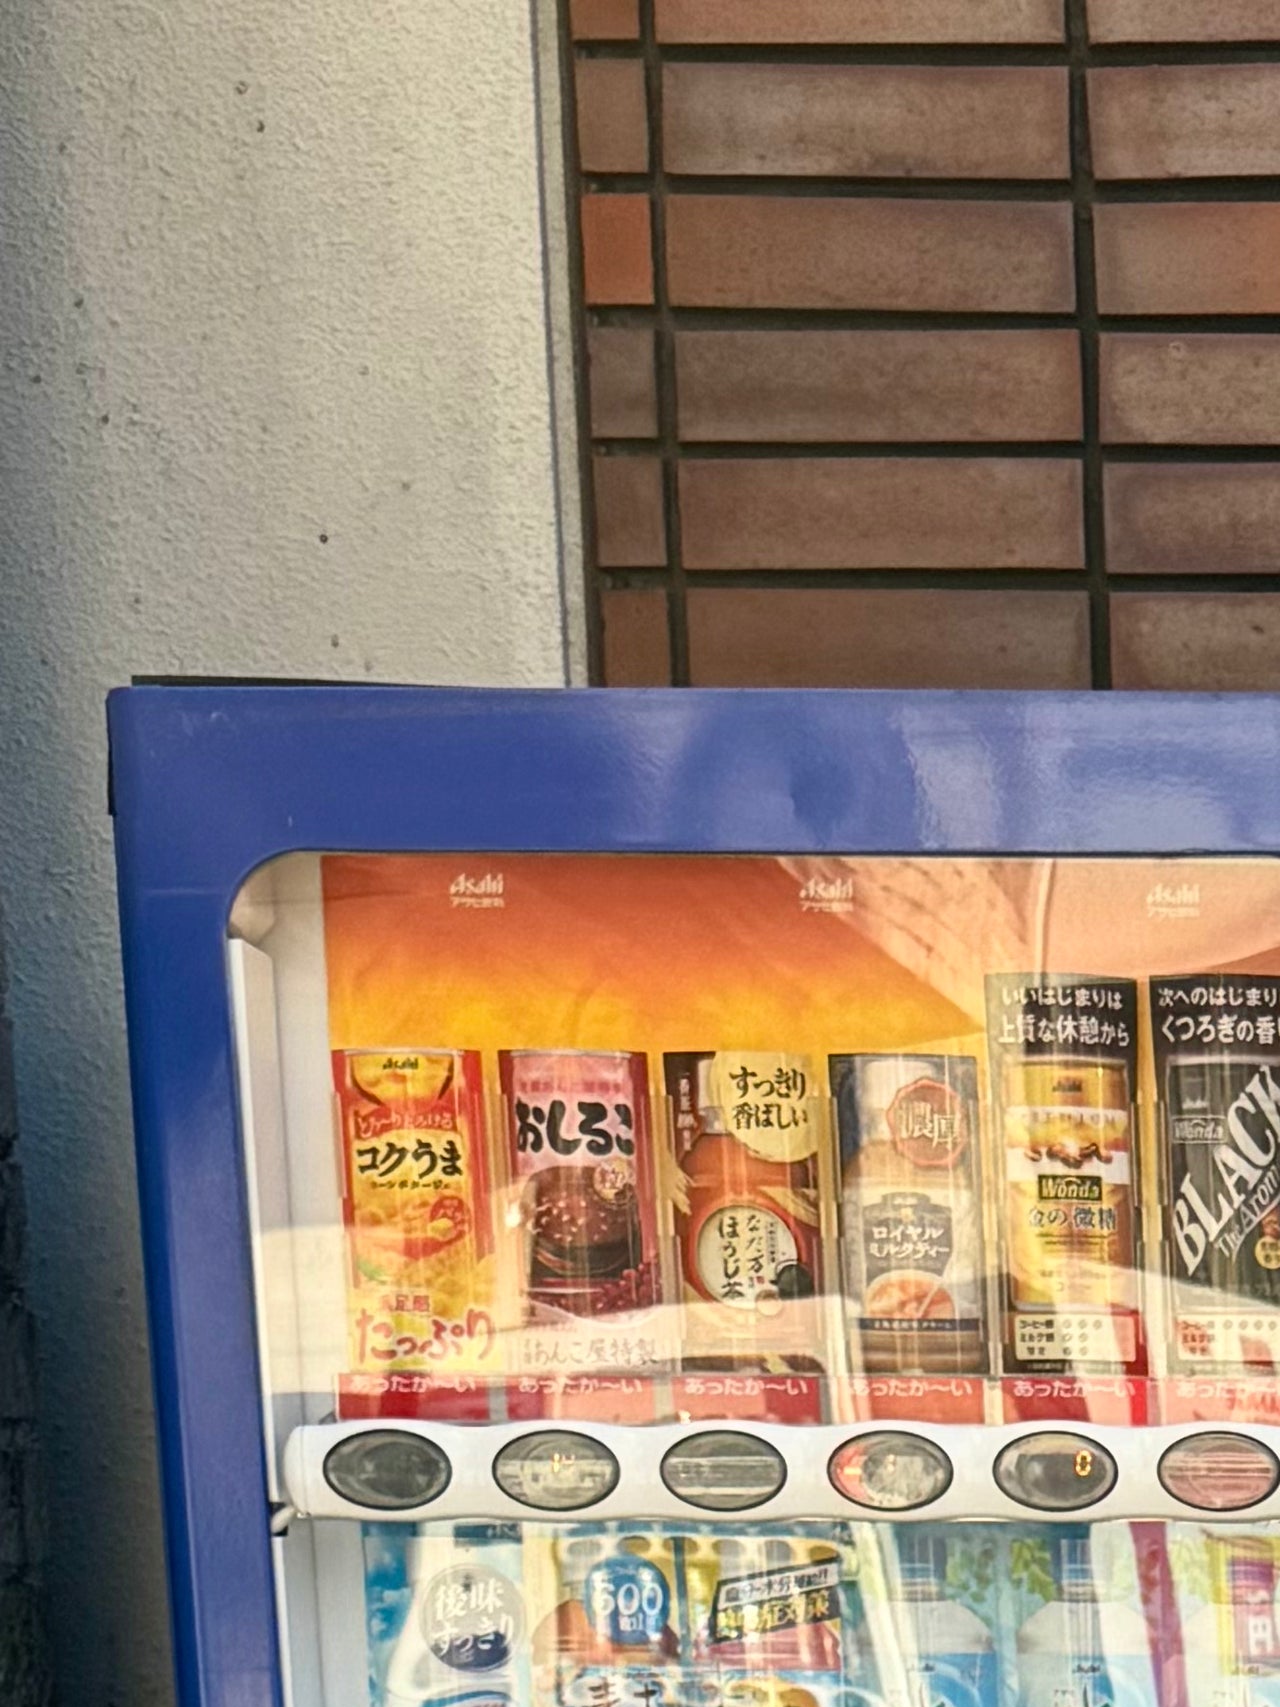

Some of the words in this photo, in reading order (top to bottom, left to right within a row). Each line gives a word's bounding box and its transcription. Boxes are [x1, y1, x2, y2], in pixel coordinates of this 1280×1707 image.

[1002, 987, 1123, 1009] いいはじまりは
[999, 1014, 1130, 1047] 上質な休憩から
[729, 1066, 806, 1100] すっきり
[515, 1097, 635, 1156] おしるこ
[733, 1102, 808, 1130] 香ばしい
[900, 1099, 961, 1150] 濃厚
[357, 1139, 463, 1179] コクうま
[870, 1240, 950, 1260] ミルクティー
[872, 1226, 944, 1242] ロイヤル
[718, 1214, 745, 1299] ほうじ茶
[356, 1308, 496, 1363] たっぷり
[591, 1583, 664, 1614] 600
